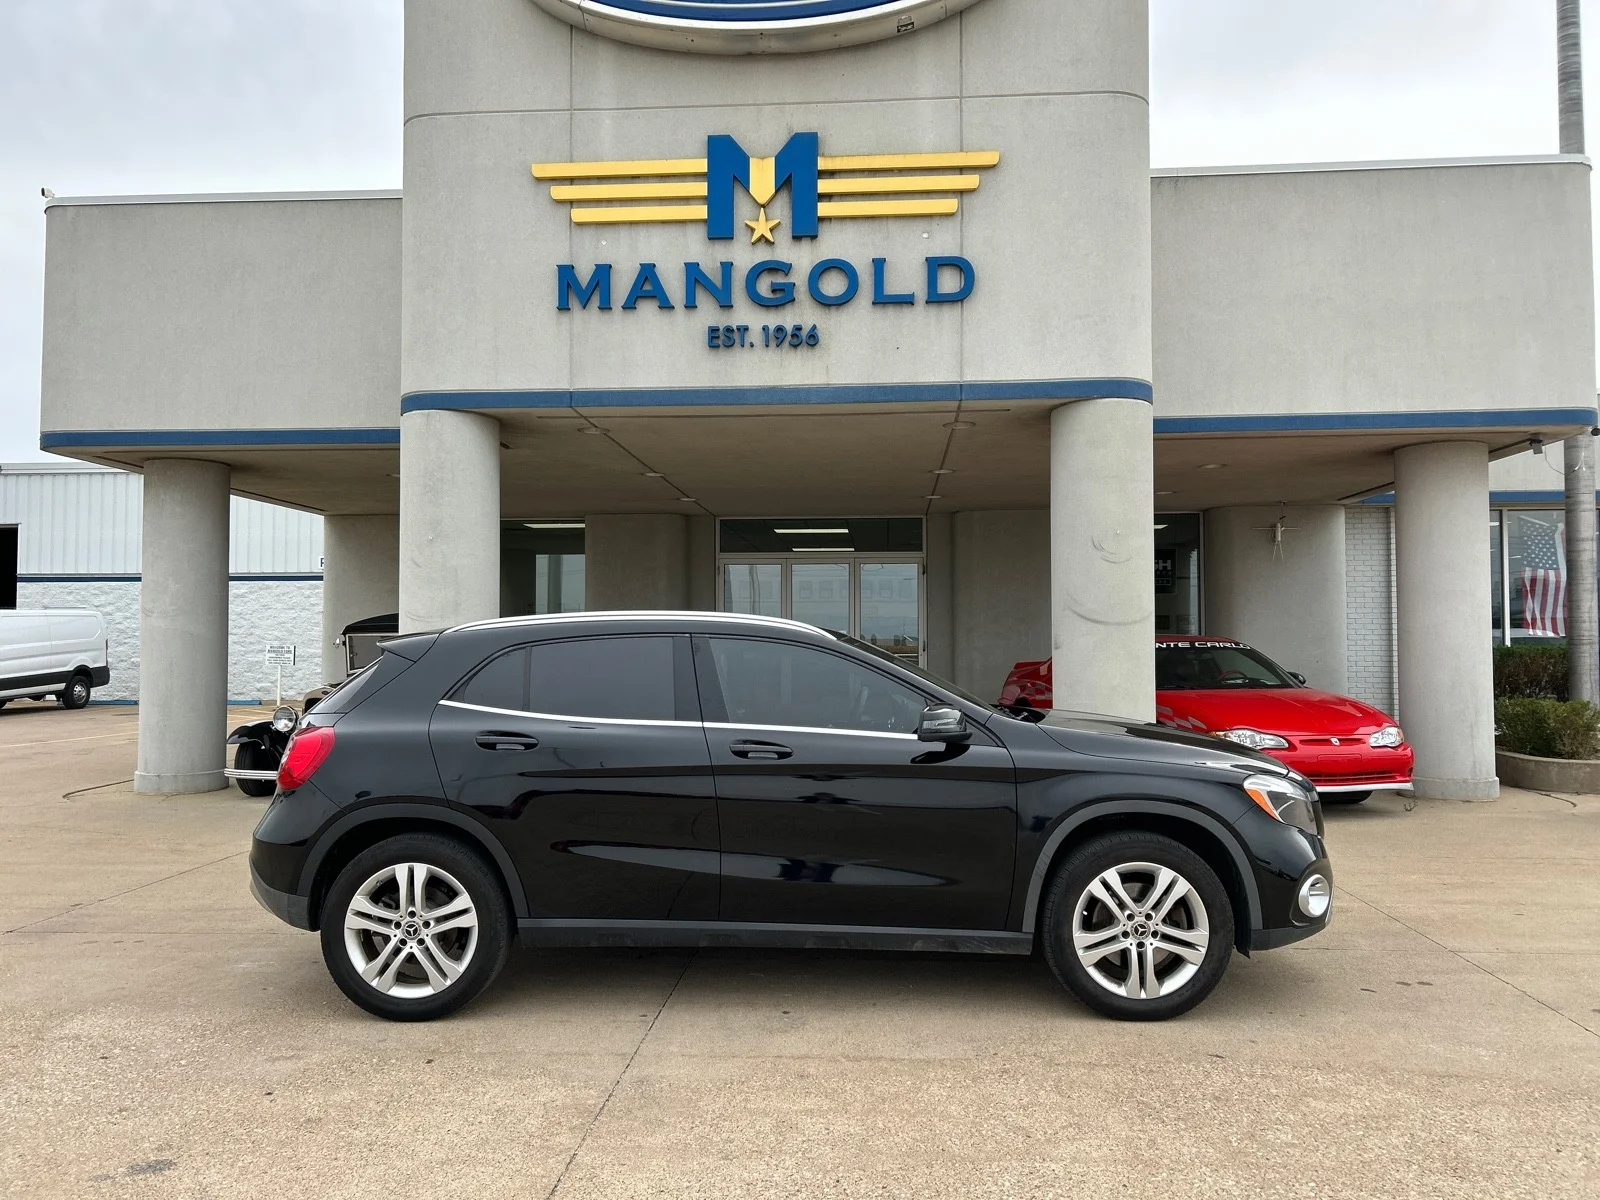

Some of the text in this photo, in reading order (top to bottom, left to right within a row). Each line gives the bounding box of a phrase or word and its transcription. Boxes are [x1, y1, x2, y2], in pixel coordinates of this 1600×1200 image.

[556, 256, 976, 311] MANGOLD
[707, 323, 820, 348] EST. 1956
[1195, 641, 1251, 649] CARLO
